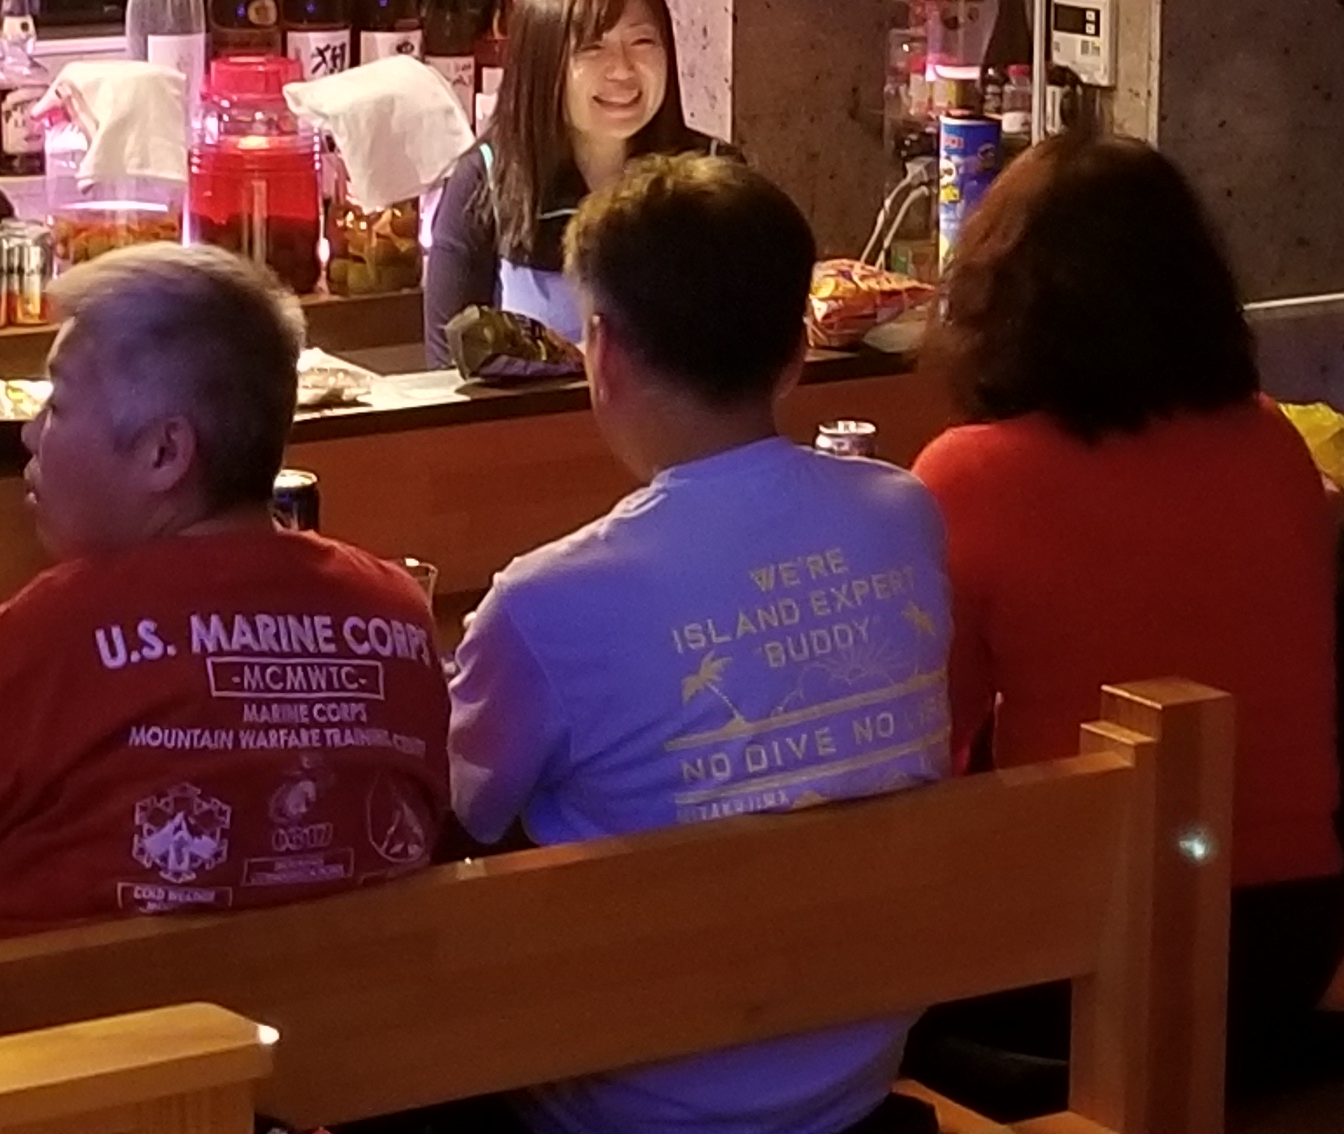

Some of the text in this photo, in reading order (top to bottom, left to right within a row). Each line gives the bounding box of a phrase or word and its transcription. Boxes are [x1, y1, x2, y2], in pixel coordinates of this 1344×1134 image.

[749, 548, 849, 592] WE'RE
[672, 567, 914, 654] ISLAND EXPERT
[95, 613, 432, 669] U.S. MARINE CORPS
[764, 617, 870, 668] BUDDY
[129, 725, 234, 750] MOUNTAIN
[239, 728, 321, 749] WARFARE
[243, 702, 368, 723] MARINE CORPS
[682, 752, 732, 783] NO
[745, 727, 836, 774] DIVE
[852, 712, 895, 744] NO
